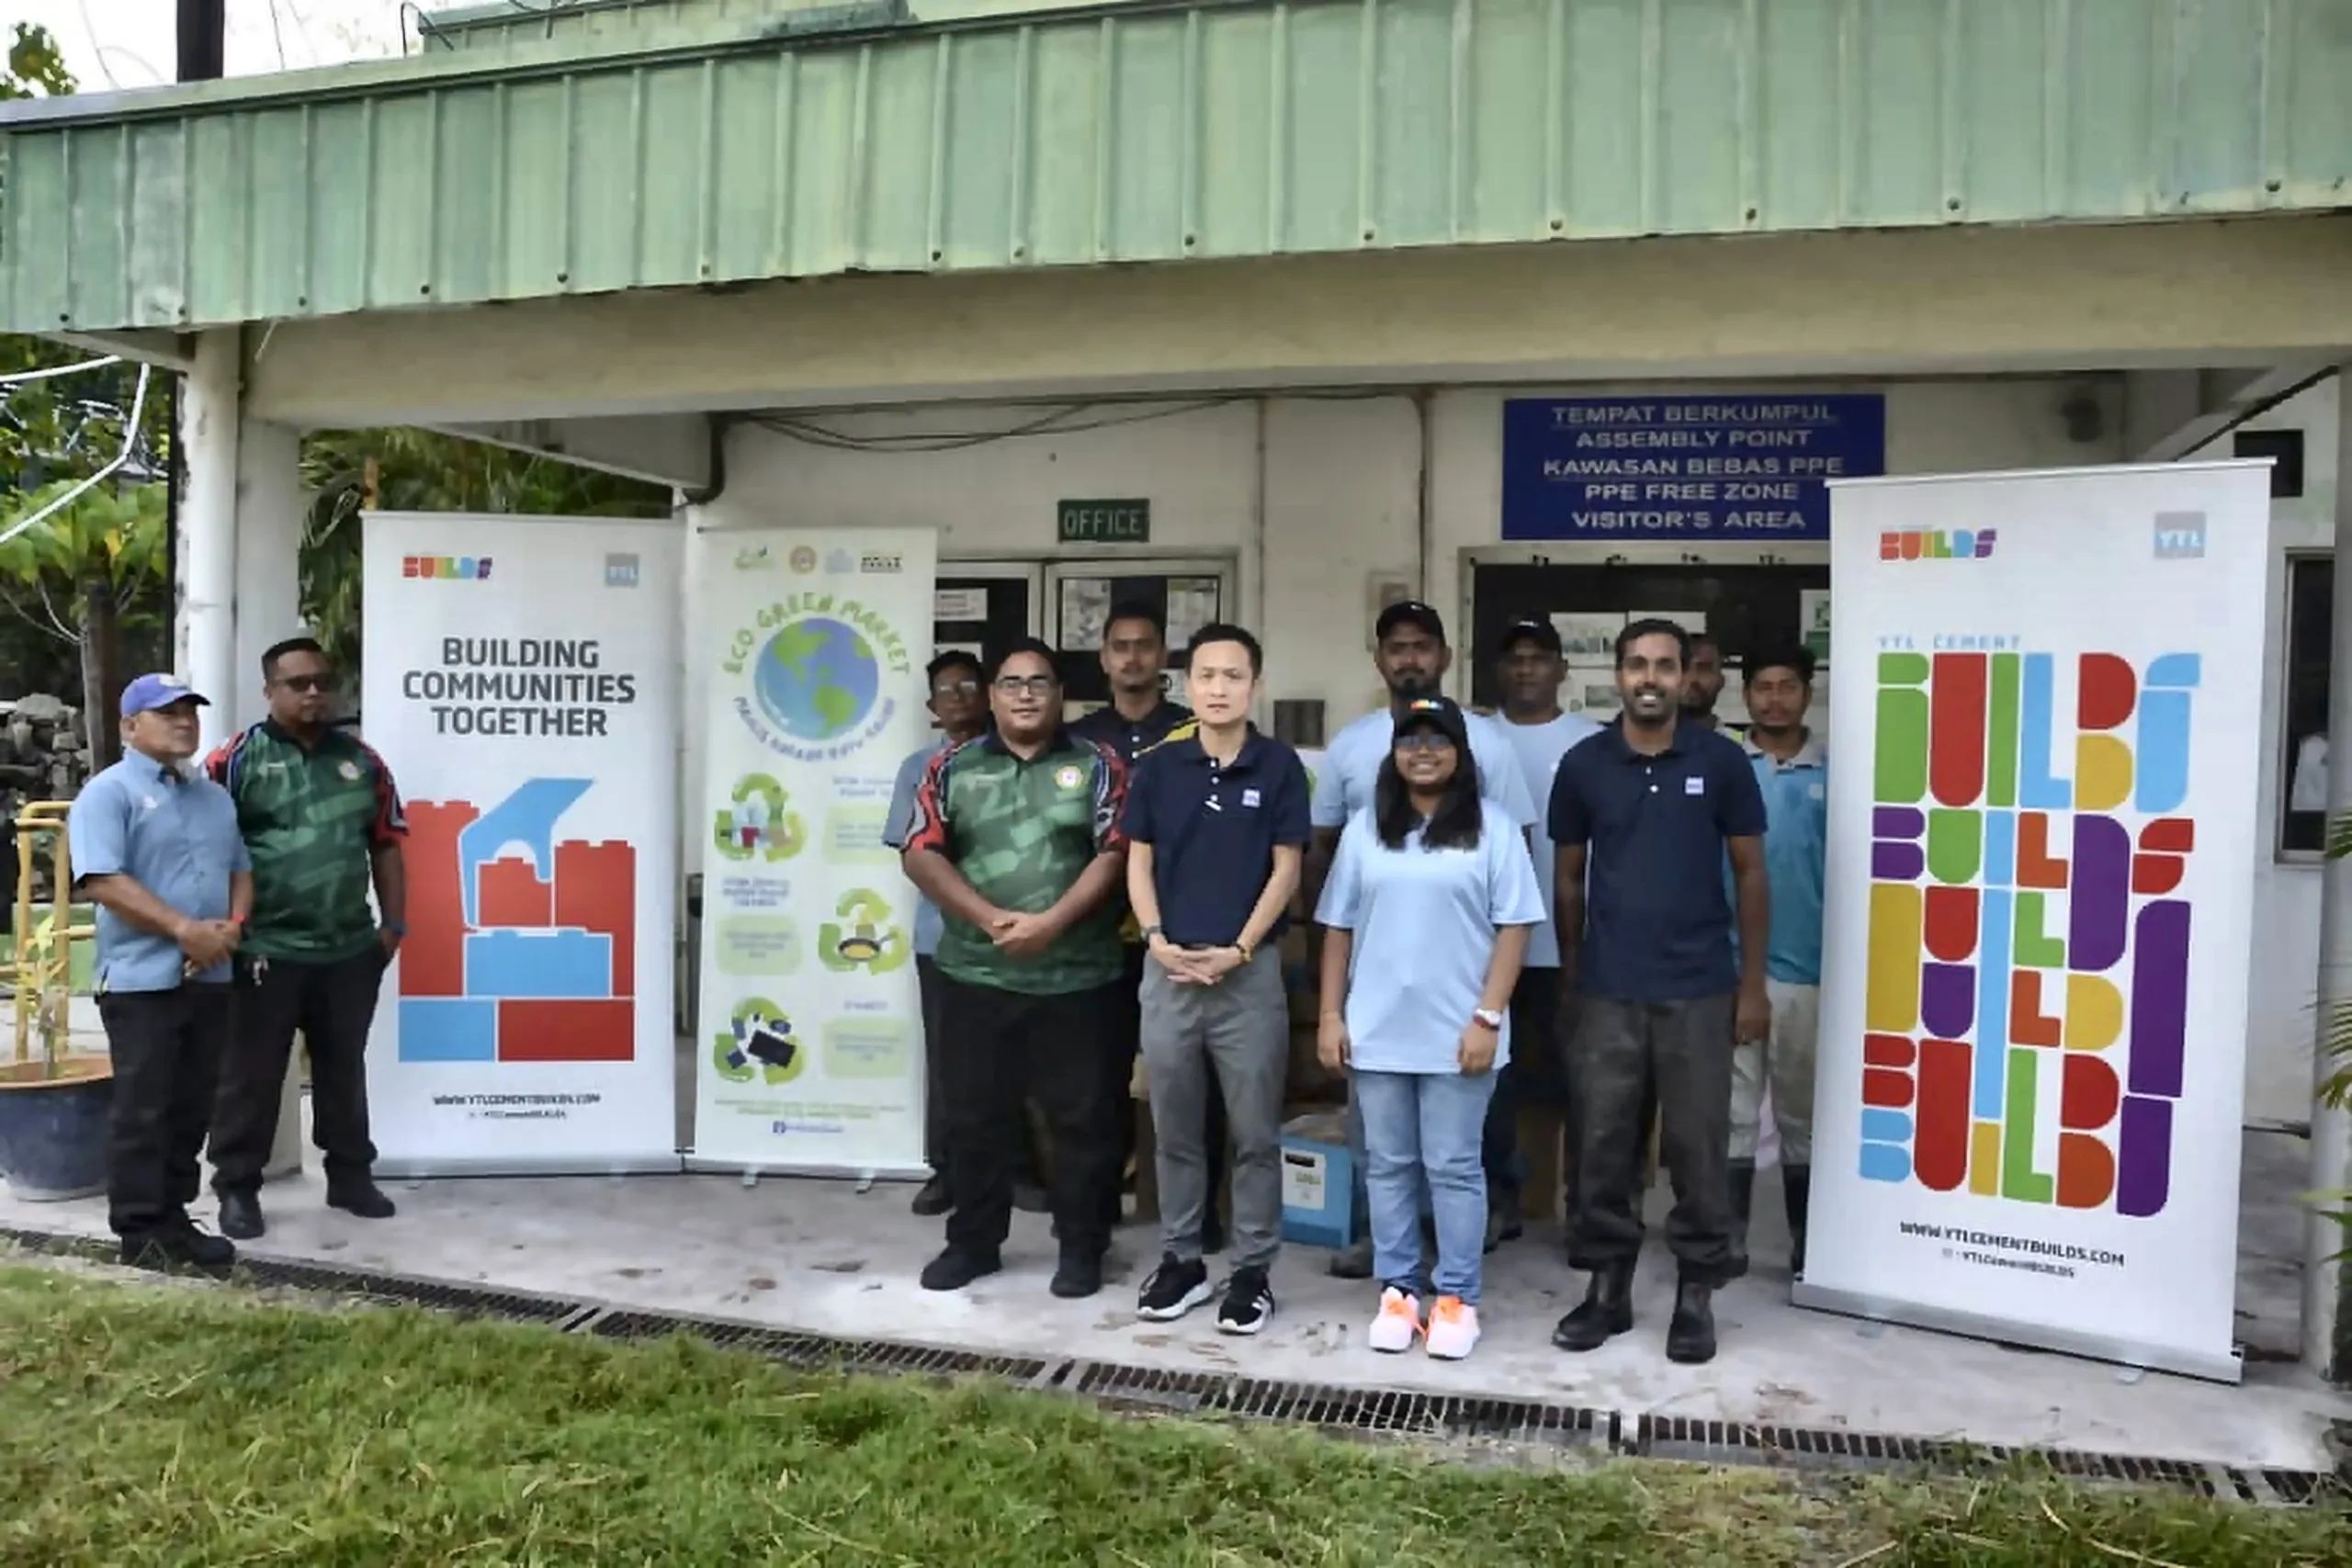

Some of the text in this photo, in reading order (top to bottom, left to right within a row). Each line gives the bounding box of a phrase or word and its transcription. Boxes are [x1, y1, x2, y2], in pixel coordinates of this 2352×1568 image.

[1552, 403, 1834, 423] TEMPAT BERKUMPUL
[1576, 430, 1812, 448] ASSEMBLY POINT
[1544, 457, 1843, 476] KAWASAN BEBAS PPE
[1585, 483, 1799, 501] PPE FREE ZONE
[1063, 508, 1143, 535] OFFICE
[1572, 511, 1806, 529] VISITOR'S AREA
[1880, 528, 1996, 560] BUILDS
[402, 557, 493, 580] BUILDS
[442, 637, 600, 669] BUILDING
[402, 671, 637, 704] COMMUNITIES
[431, 705, 608, 737] TOGETHER
